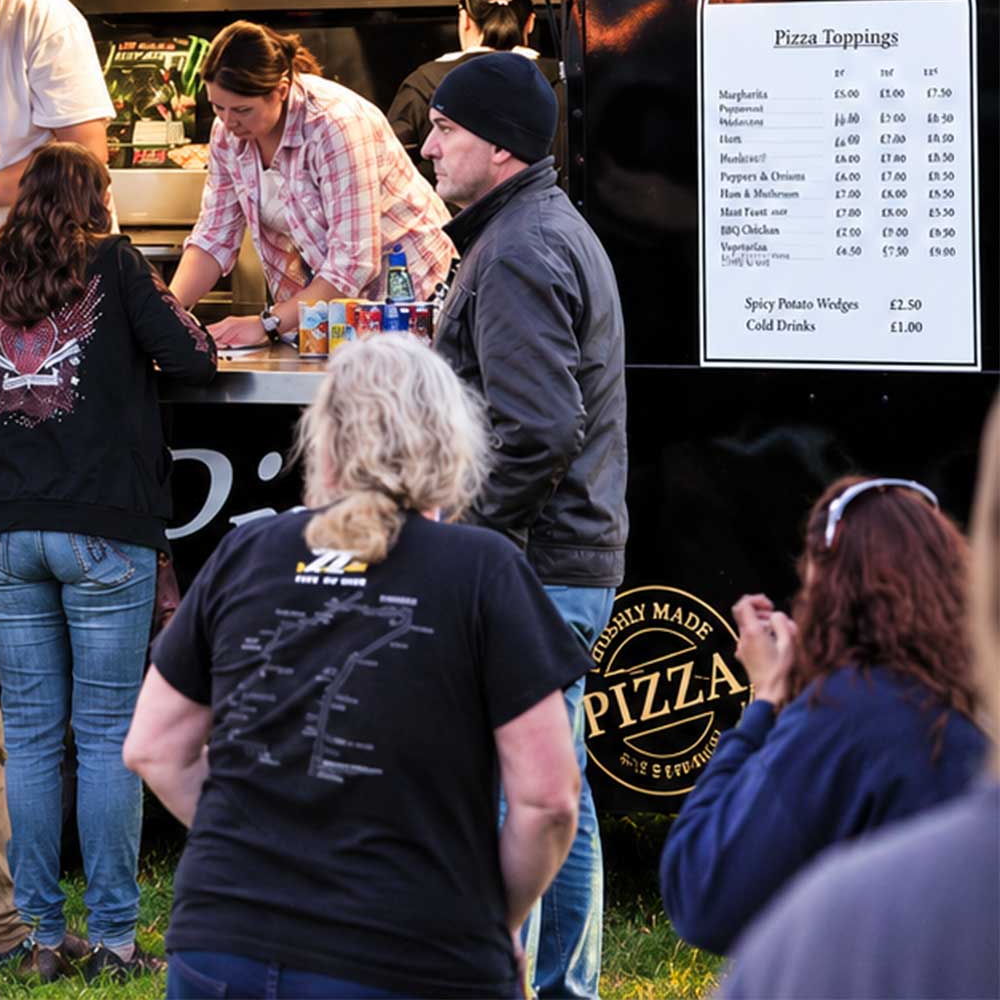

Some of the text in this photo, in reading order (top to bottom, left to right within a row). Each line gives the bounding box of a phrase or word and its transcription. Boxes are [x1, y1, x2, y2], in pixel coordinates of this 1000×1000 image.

[774, 28, 899, 50] Pizza Toppings
[745, 297, 922, 314] Spicy Potato Wedges £2.50
[746, 319, 923, 333] Cold Drinks £1.00
[652, 602, 714, 640] MADE
[583, 652, 748, 738] PIZZA
